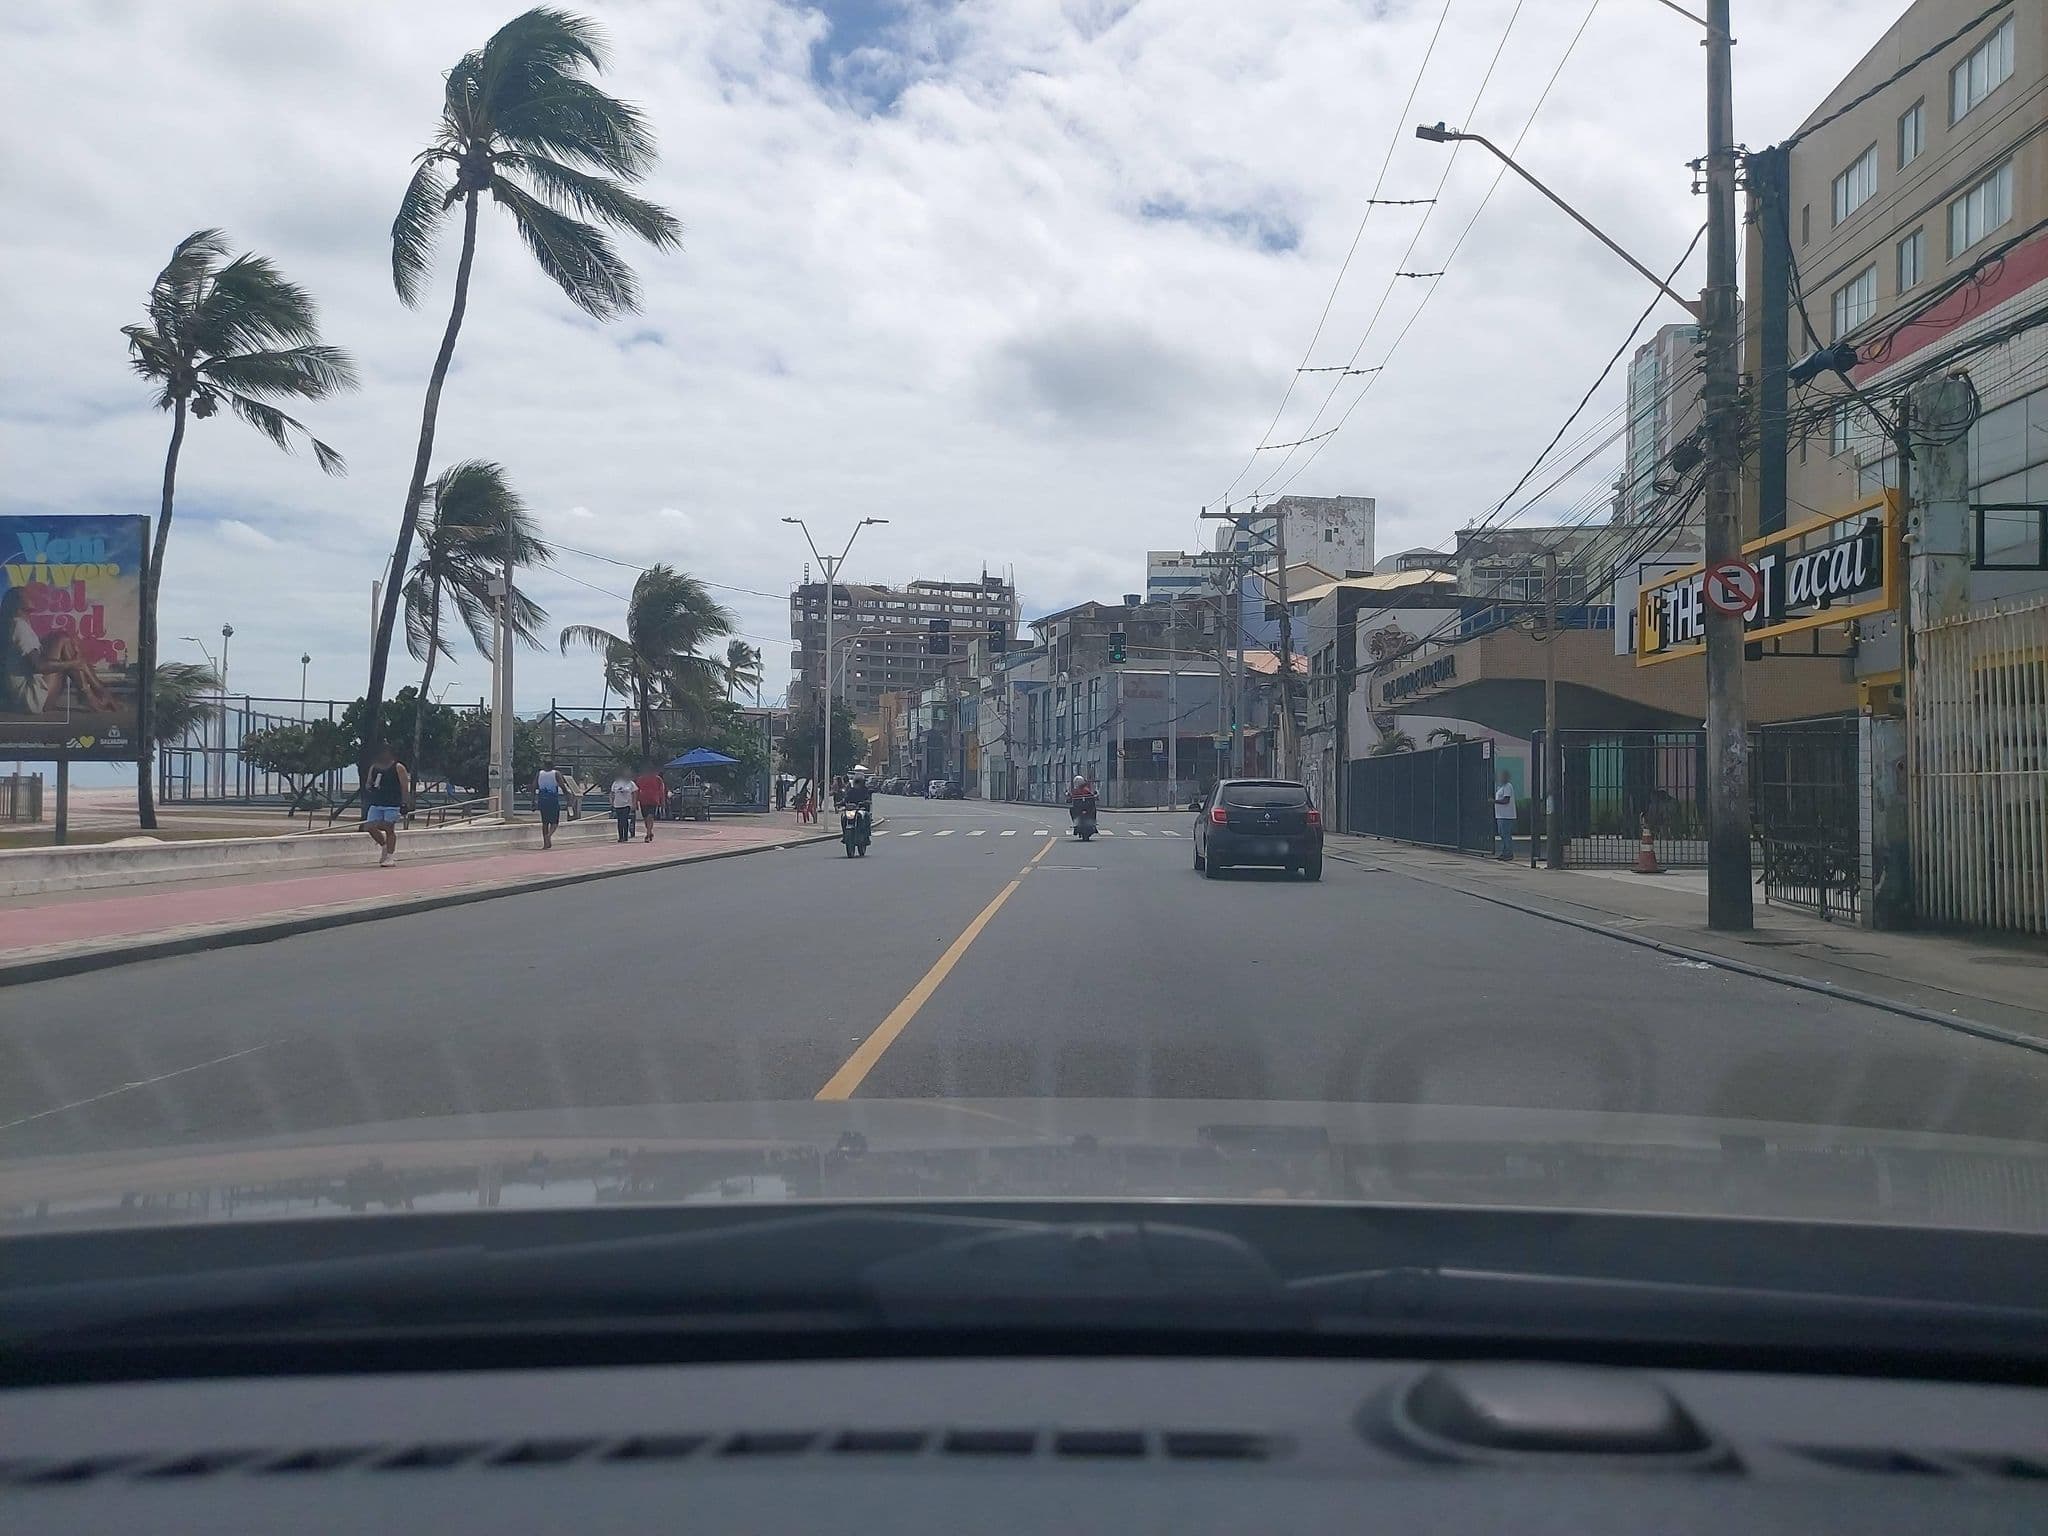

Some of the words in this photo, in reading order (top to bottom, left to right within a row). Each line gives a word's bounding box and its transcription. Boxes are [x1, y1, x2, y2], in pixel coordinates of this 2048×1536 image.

[15, 531, 105, 564] Vem
[5, 551, 121, 588] viver
[1665, 576, 1705, 644] THE
[1789, 516, 1868, 610] açaí
[24, 580, 88, 613] Sal
